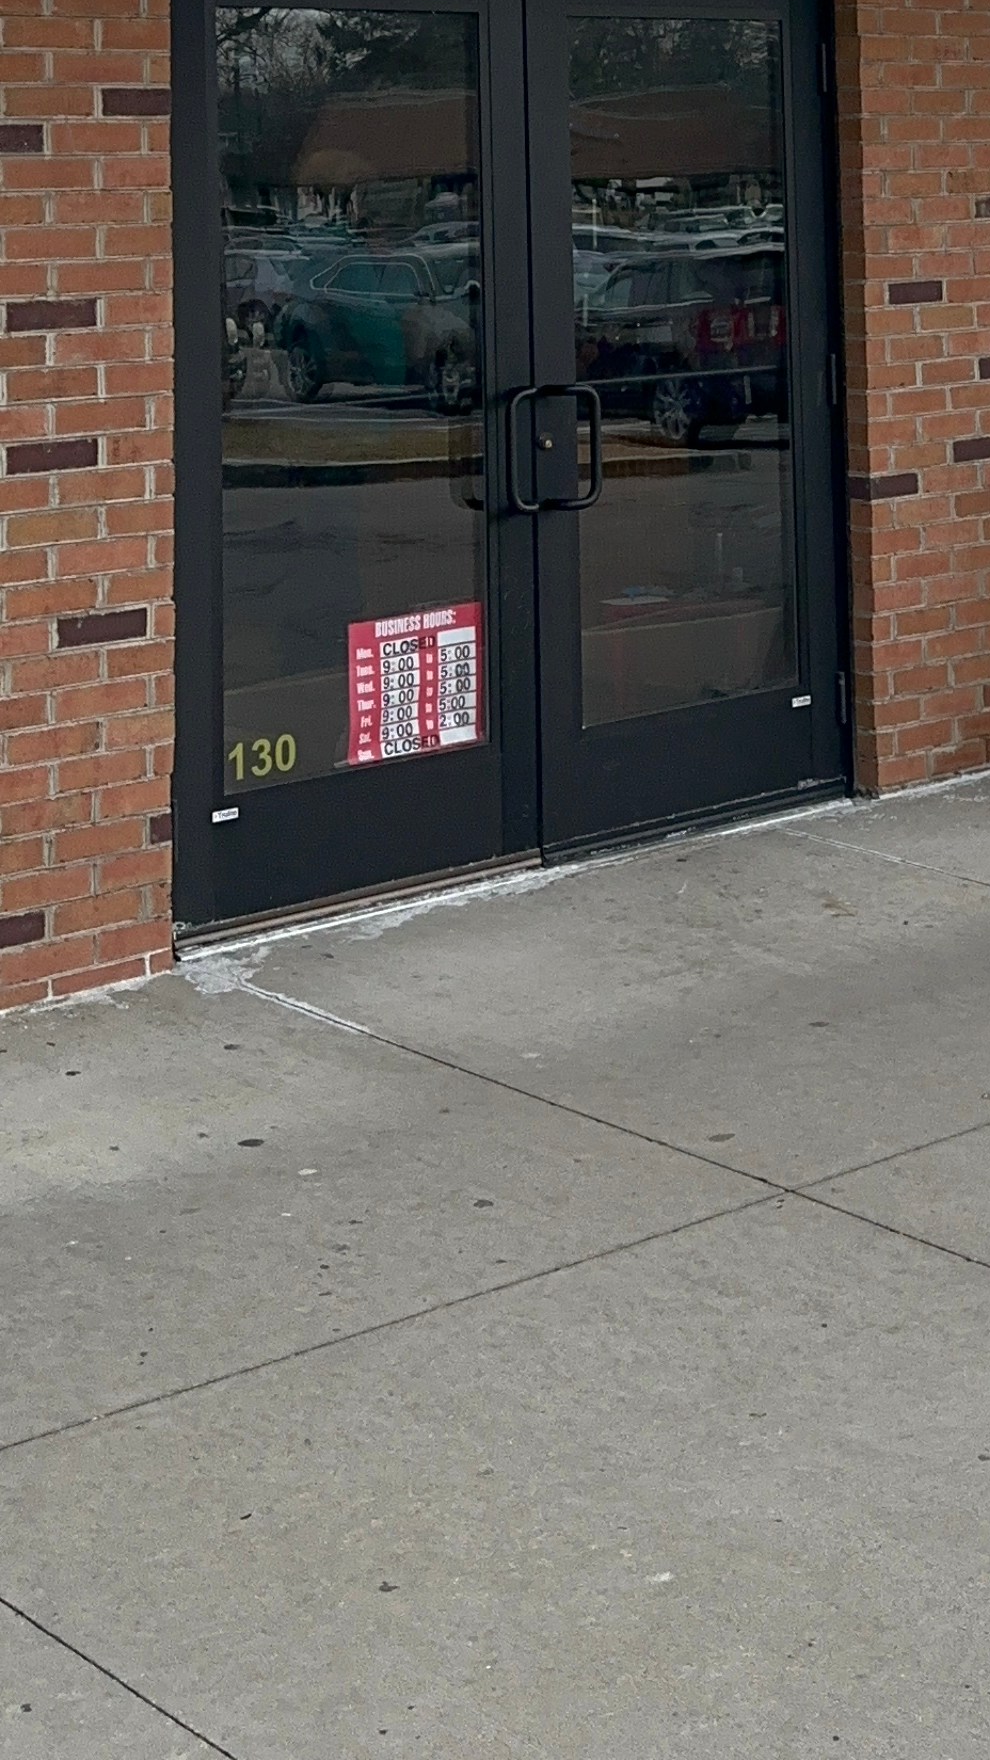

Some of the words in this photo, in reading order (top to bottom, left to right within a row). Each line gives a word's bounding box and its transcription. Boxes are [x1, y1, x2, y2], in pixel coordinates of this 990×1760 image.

[375, 614, 421, 638] BUSINESS
[382, 656, 414, 673] 9:00
[440, 645, 471, 662] 5:00
[383, 672, 414, 690] 9:00
[382, 689, 414, 707] 9:00
[382, 705, 413, 723] 9:00
[381, 722, 413, 740] 9:00
[227, 734, 297, 781] 130
